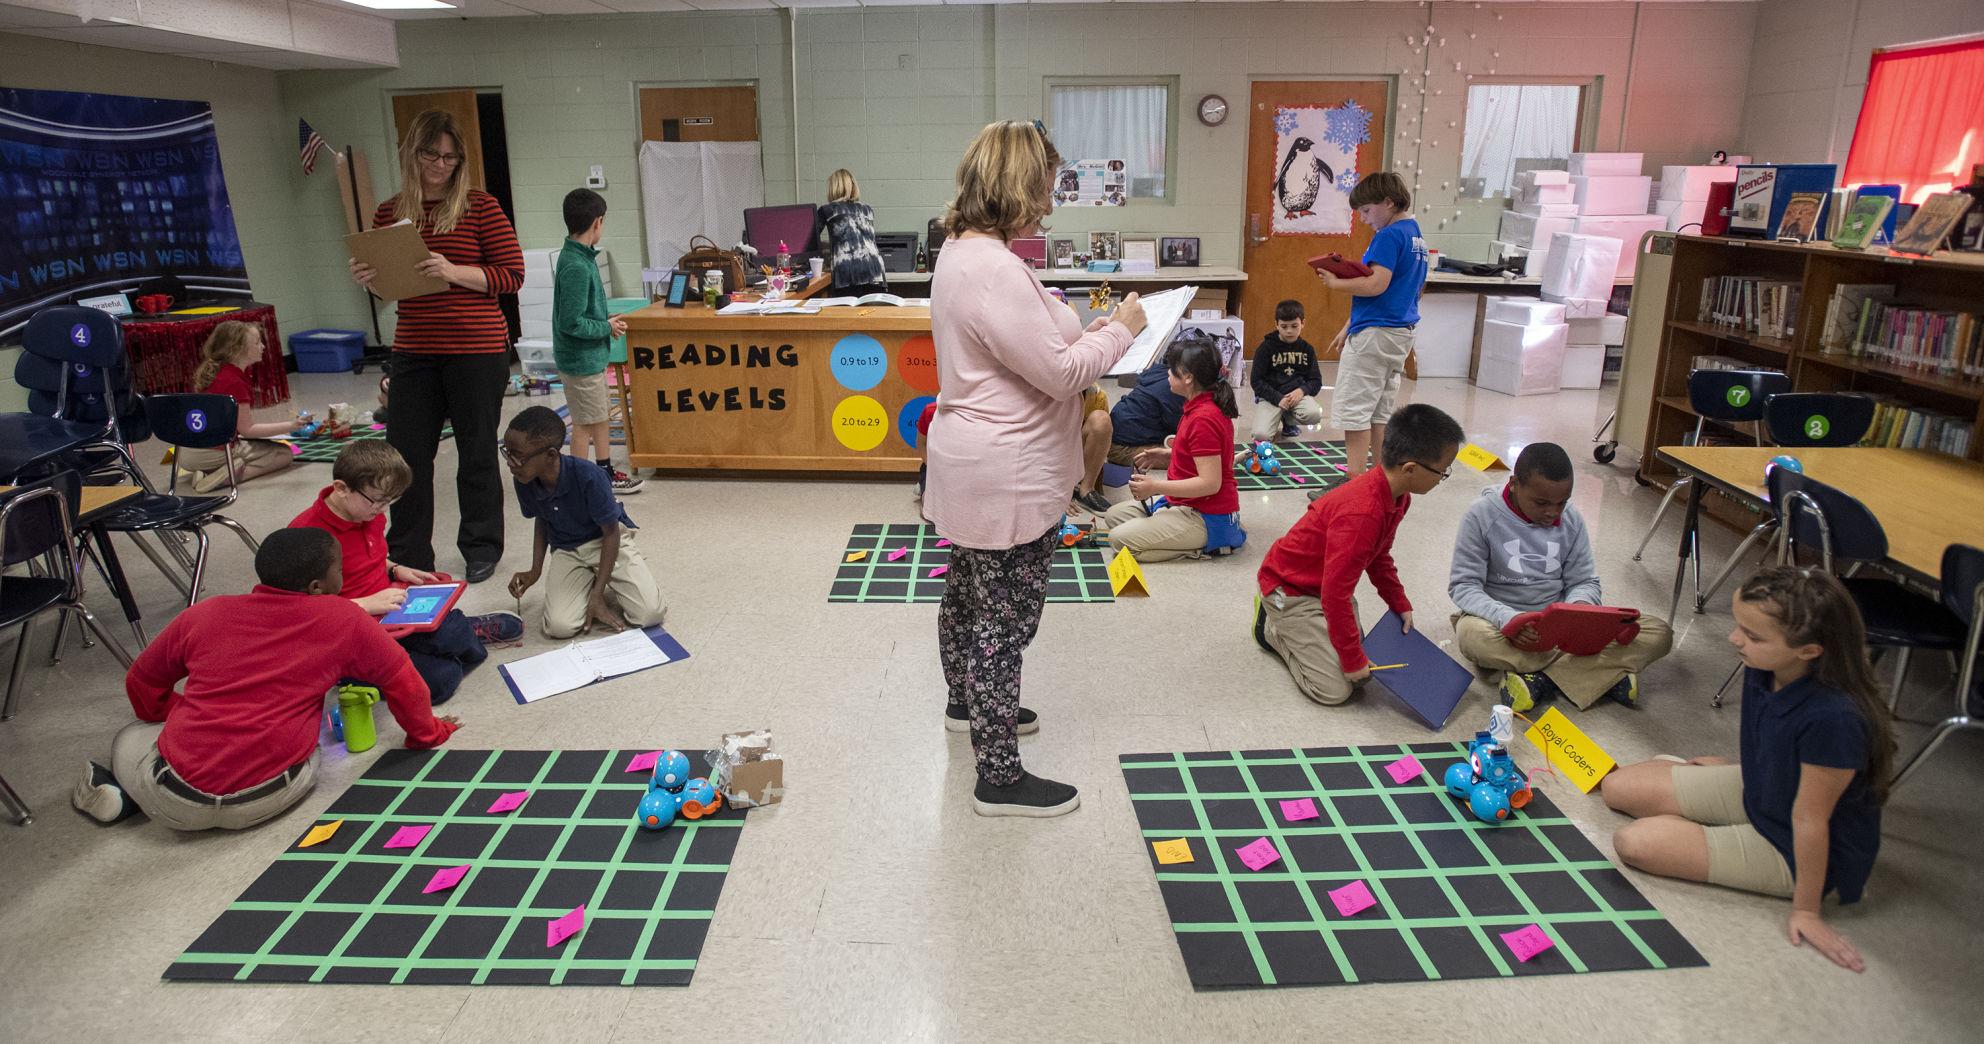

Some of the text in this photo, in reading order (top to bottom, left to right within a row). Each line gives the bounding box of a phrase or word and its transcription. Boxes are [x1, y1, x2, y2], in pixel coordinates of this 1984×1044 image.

[75, 151, 129, 169] WSN
[135, 148, 184, 168] WSN
[192, 143, 216, 161] WS
[1738, 171, 1774, 196] pencils
[30, 256, 86, 285] WSN
[93, 250, 147, 271] WSN
[155, 248, 200, 266] WSN
[206, 250, 243, 268] WS
[75, 327, 86, 343] 4
[632, 343, 799, 370] READING
[840, 356, 880, 366] 0.9 to 1.9
[906, 356, 920, 366] 3.0
[921, 358, 931, 367] to
[1272, 351, 1308, 367] SAINTS
[657, 386, 786, 413] LEVELS
[1732, 389, 1747, 404] 7
[191, 413, 203, 430] 3
[842, 417, 880, 427] 2.0 to 2.9
[1809, 420, 1823, 437] 2
[1541, 723, 1596, 777] Royal Coders
